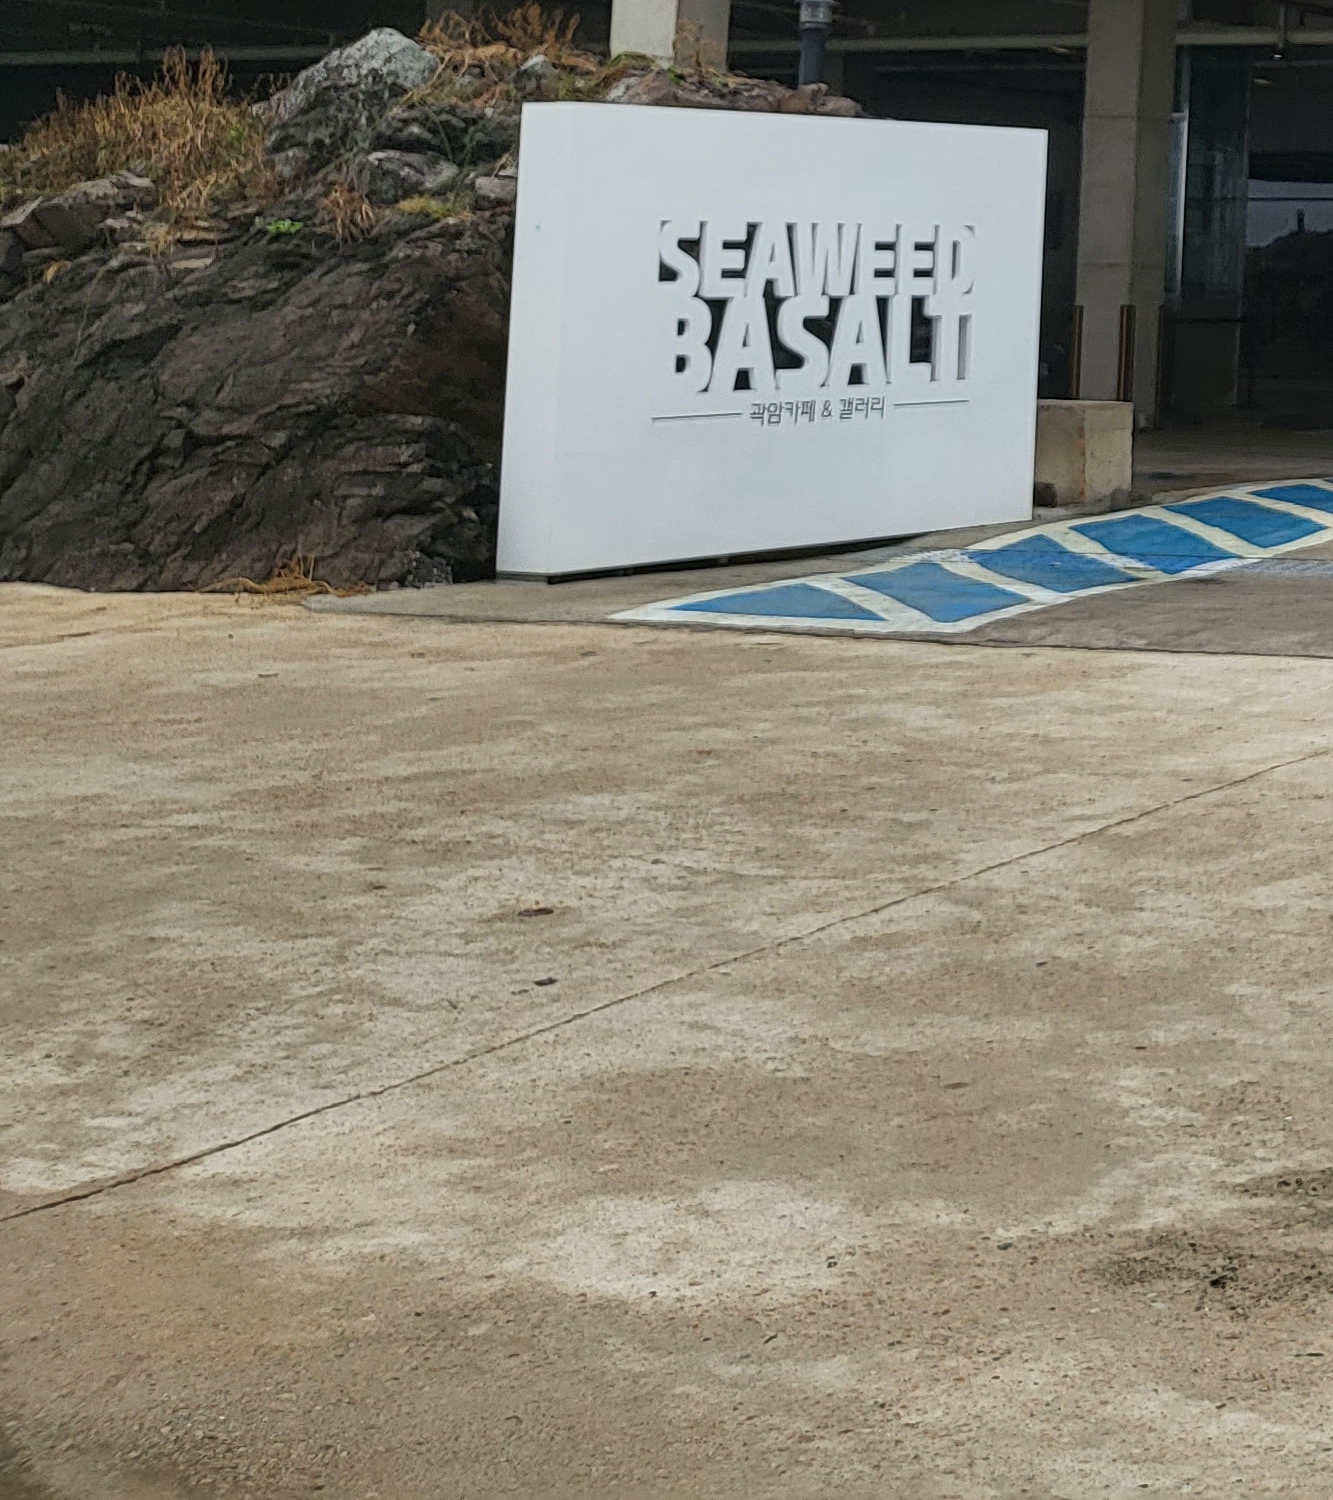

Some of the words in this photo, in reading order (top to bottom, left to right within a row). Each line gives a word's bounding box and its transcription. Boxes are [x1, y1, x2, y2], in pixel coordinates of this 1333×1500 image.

[657, 219, 976, 299] SEAWEED
[661, 294, 974, 393] BASALT
[750, 399, 816, 426] 곽암카페
[821, 400, 833, 419] &
[839, 396, 885, 420] 갤러리
